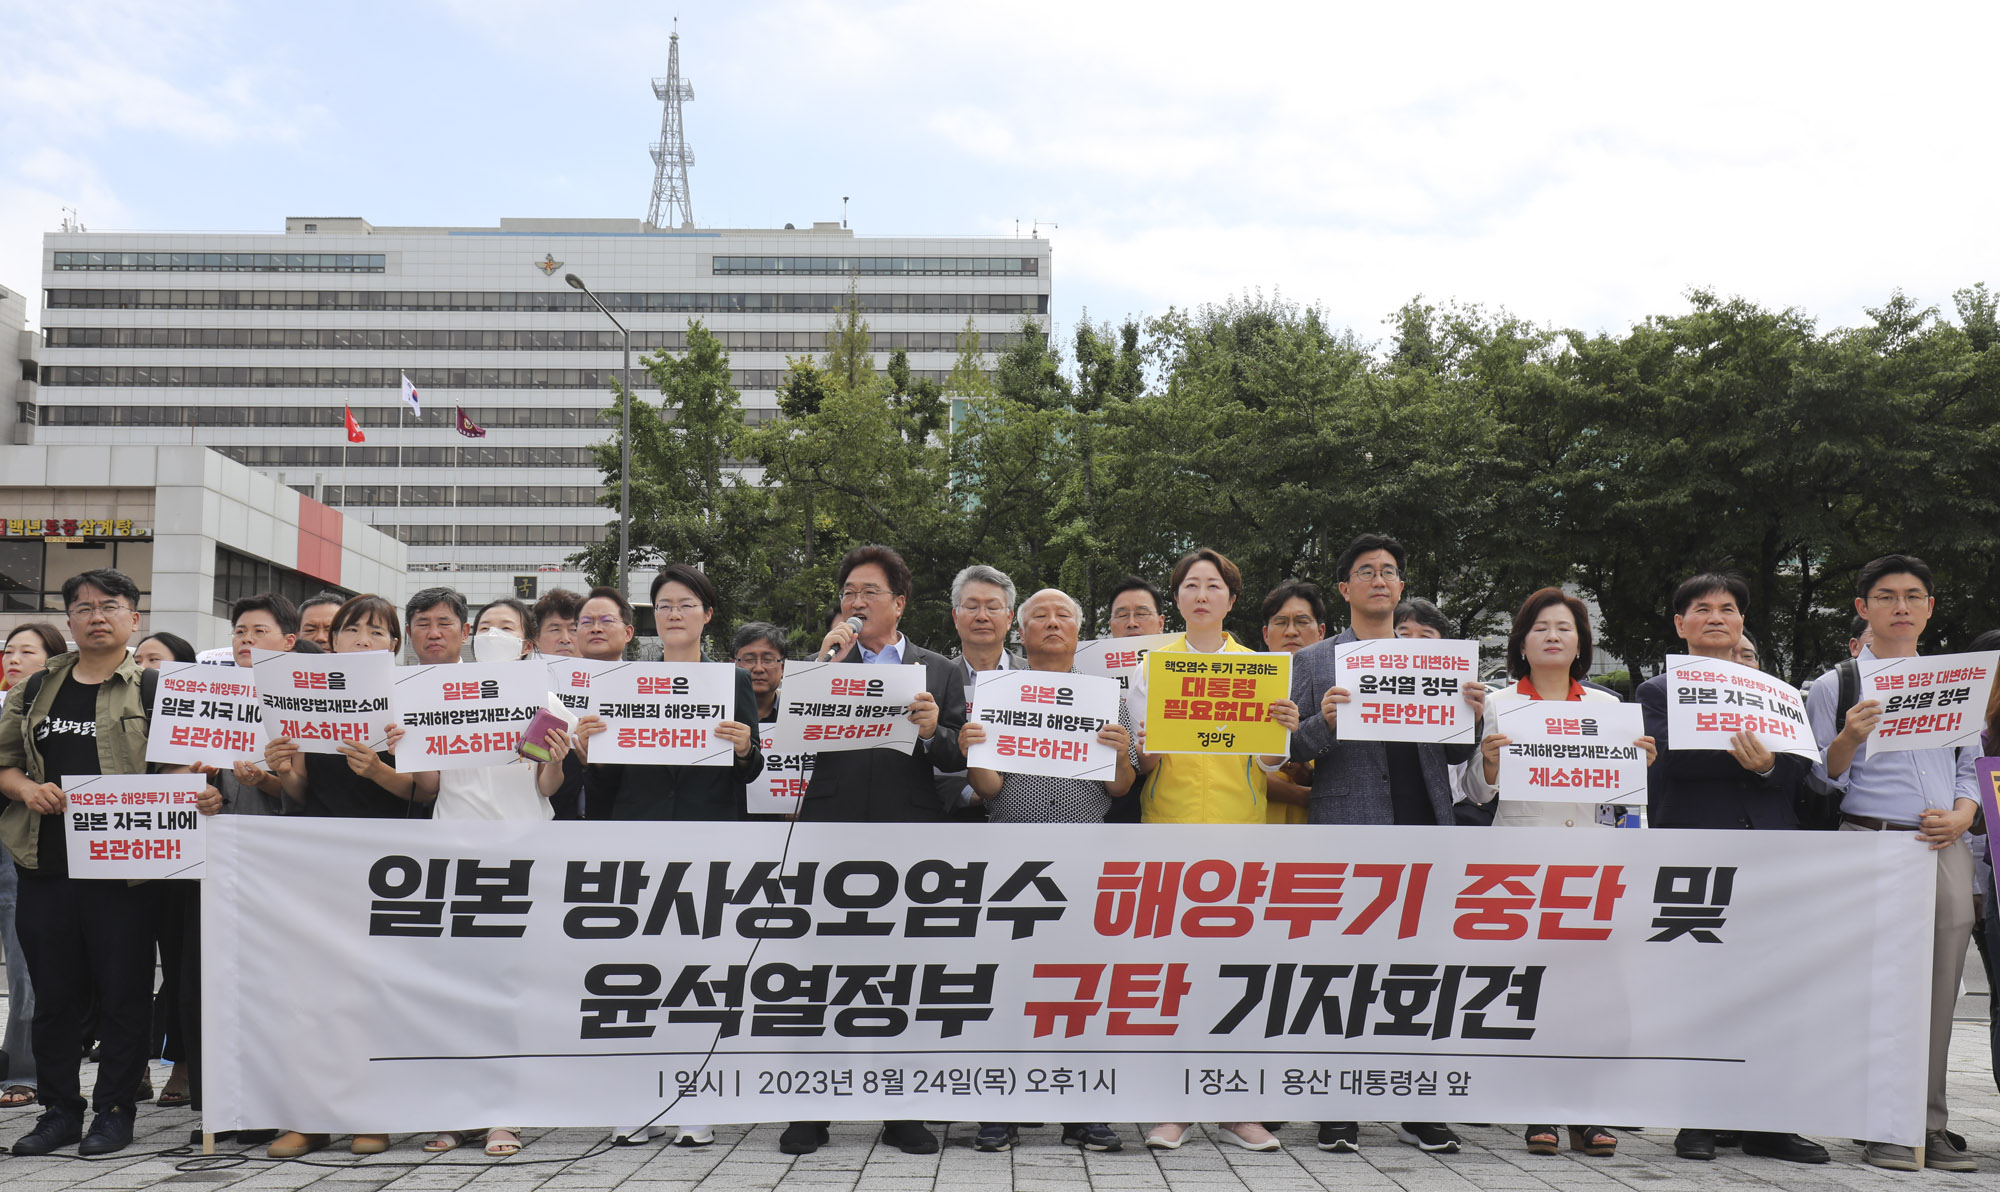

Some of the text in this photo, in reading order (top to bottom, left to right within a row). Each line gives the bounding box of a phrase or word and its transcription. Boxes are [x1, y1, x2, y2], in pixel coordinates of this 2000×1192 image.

[1165, 661, 1278, 675] 핵오염수 투기 구경하는
[1346, 654, 1470, 671] 일본 입장 대변하는
[164, 679, 207, 694] 핵오염수
[209, 682, 250, 697] 해양투기
[292, 671, 346, 690] 일본을
[571, 671, 590, 688] 일
[637, 676, 689, 695] 일본은
[831, 678, 884, 697] 일본은
[1181, 677, 1257, 699] 대통령
[1359, 675, 1458, 697] 윤석열 정부
[1676, 669, 1728, 683] 핵오염수
[1731, 675, 1777, 697] 해양투기
[1873, 667, 1987, 690] 일본 입장 대변하는
[442, 680, 499, 700] 일본을
[1020, 685, 1074, 706] 일본은
[161, 697, 195, 718] 일본
[199, 701, 233, 721] 자국
[262, 693, 388, 713] 국제해양법재판소에
[788, 702, 851, 717] 국제범죄
[1677, 687, 1804, 725] 일본 자국 내에
[1885, 687, 1970, 714] 윤석열 정부
[599, 703, 725, 719] 국제범죄 해양투기
[980, 709, 1042, 728] 국제범죄
[1360, 703, 1455, 726] 규탄한다!
[279, 719, 369, 741] 제소하라!
[803, 723, 893, 740] 중단하라!
[1544, 718, 1599, 736] 일본을
[1696, 712, 1797, 740] 보관하라!
[1878, 712, 1963, 738] 규탄한다!
[169, 725, 255, 752] 보관하라!
[617, 728, 706, 748] 중단하라!
[1197, 732, 1235, 748] 정의당
[996, 735, 1088, 762] 중단하라!
[1508, 743, 1638, 760] 국제해양법재판소에
[769, 778, 808, 797] 규탄
[1528, 767, 1620, 789] 제소하라!
[70, 791, 199, 805] 핵오염수 해양투기 말고
[72, 811, 198, 831] 일본 자국 내에
[89, 839, 181, 860] 보관하라!
[368, 855, 1738, 944] 일본 방사성오염수 해양투기 중단 및
[579, 962, 1548, 1041] 윤석열정부 규탄 기자회견
[758, 1070, 853, 1096] 2023년
[862, 1069, 904, 1096] 8월
[912, 1068, 1017, 1096] 24일(목)
[1024, 1068, 1117, 1096] 오후1시
[1282, 1069, 1331, 1095] 용산
[1340, 1070, 1437, 1095] 대통령실
[1446, 1071, 1471, 1096] 앞
